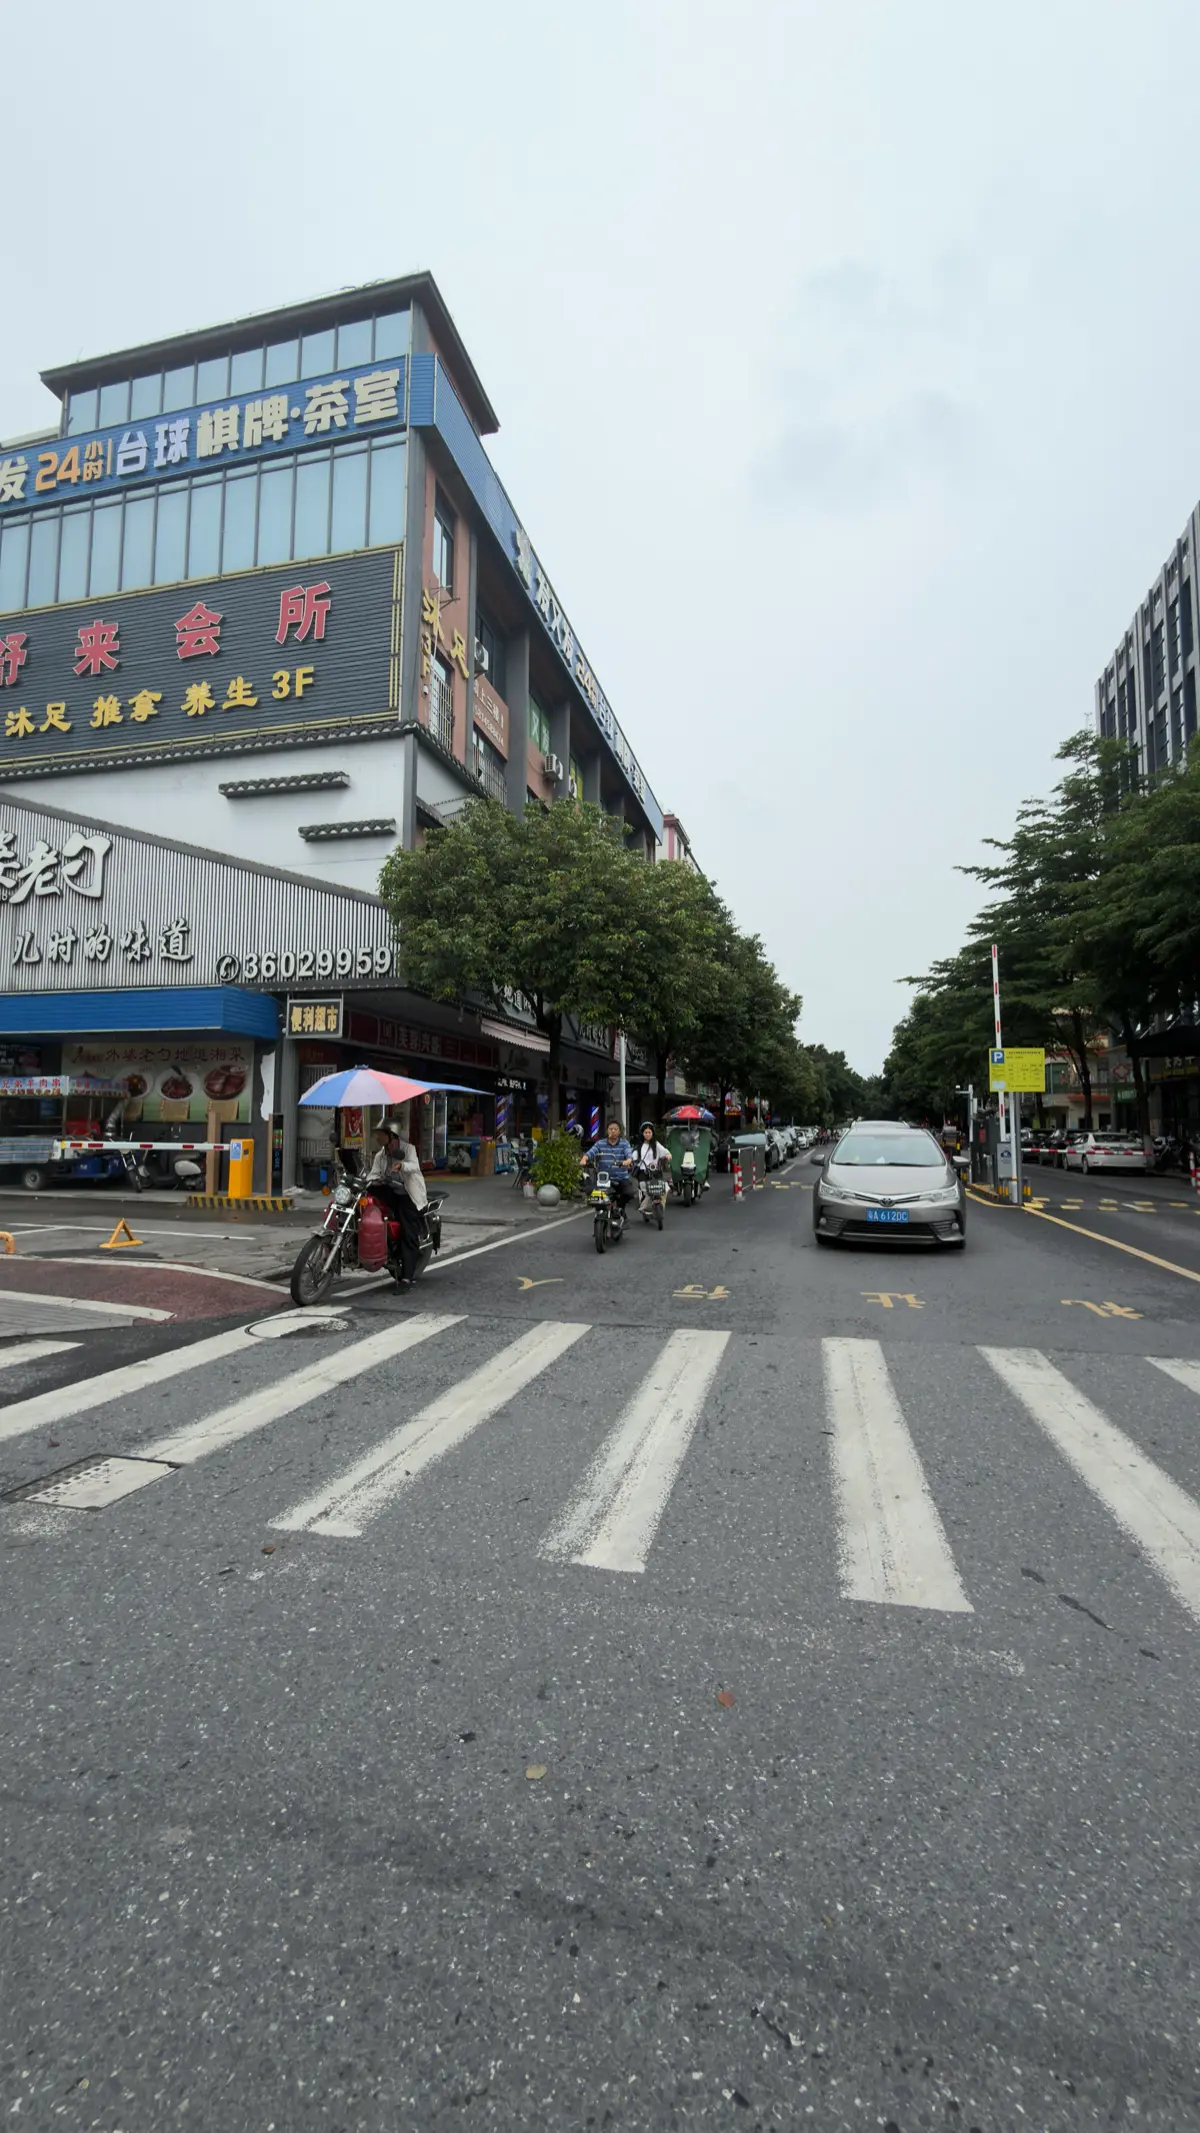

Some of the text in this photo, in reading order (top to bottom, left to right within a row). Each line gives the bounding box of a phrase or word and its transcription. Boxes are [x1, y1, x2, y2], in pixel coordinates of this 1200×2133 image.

[5, 666, 315, 738] 沐足 推拿 养生 3F
[12, 916, 194, 966] 儿时的味道
[243, 945, 391, 980] 36029959
[290, 1004, 339, 1033] 便利超市
[105, 1046, 246, 1063] 外婆老勺地道湘菜
[993, 1051, 1003, 1063] P
